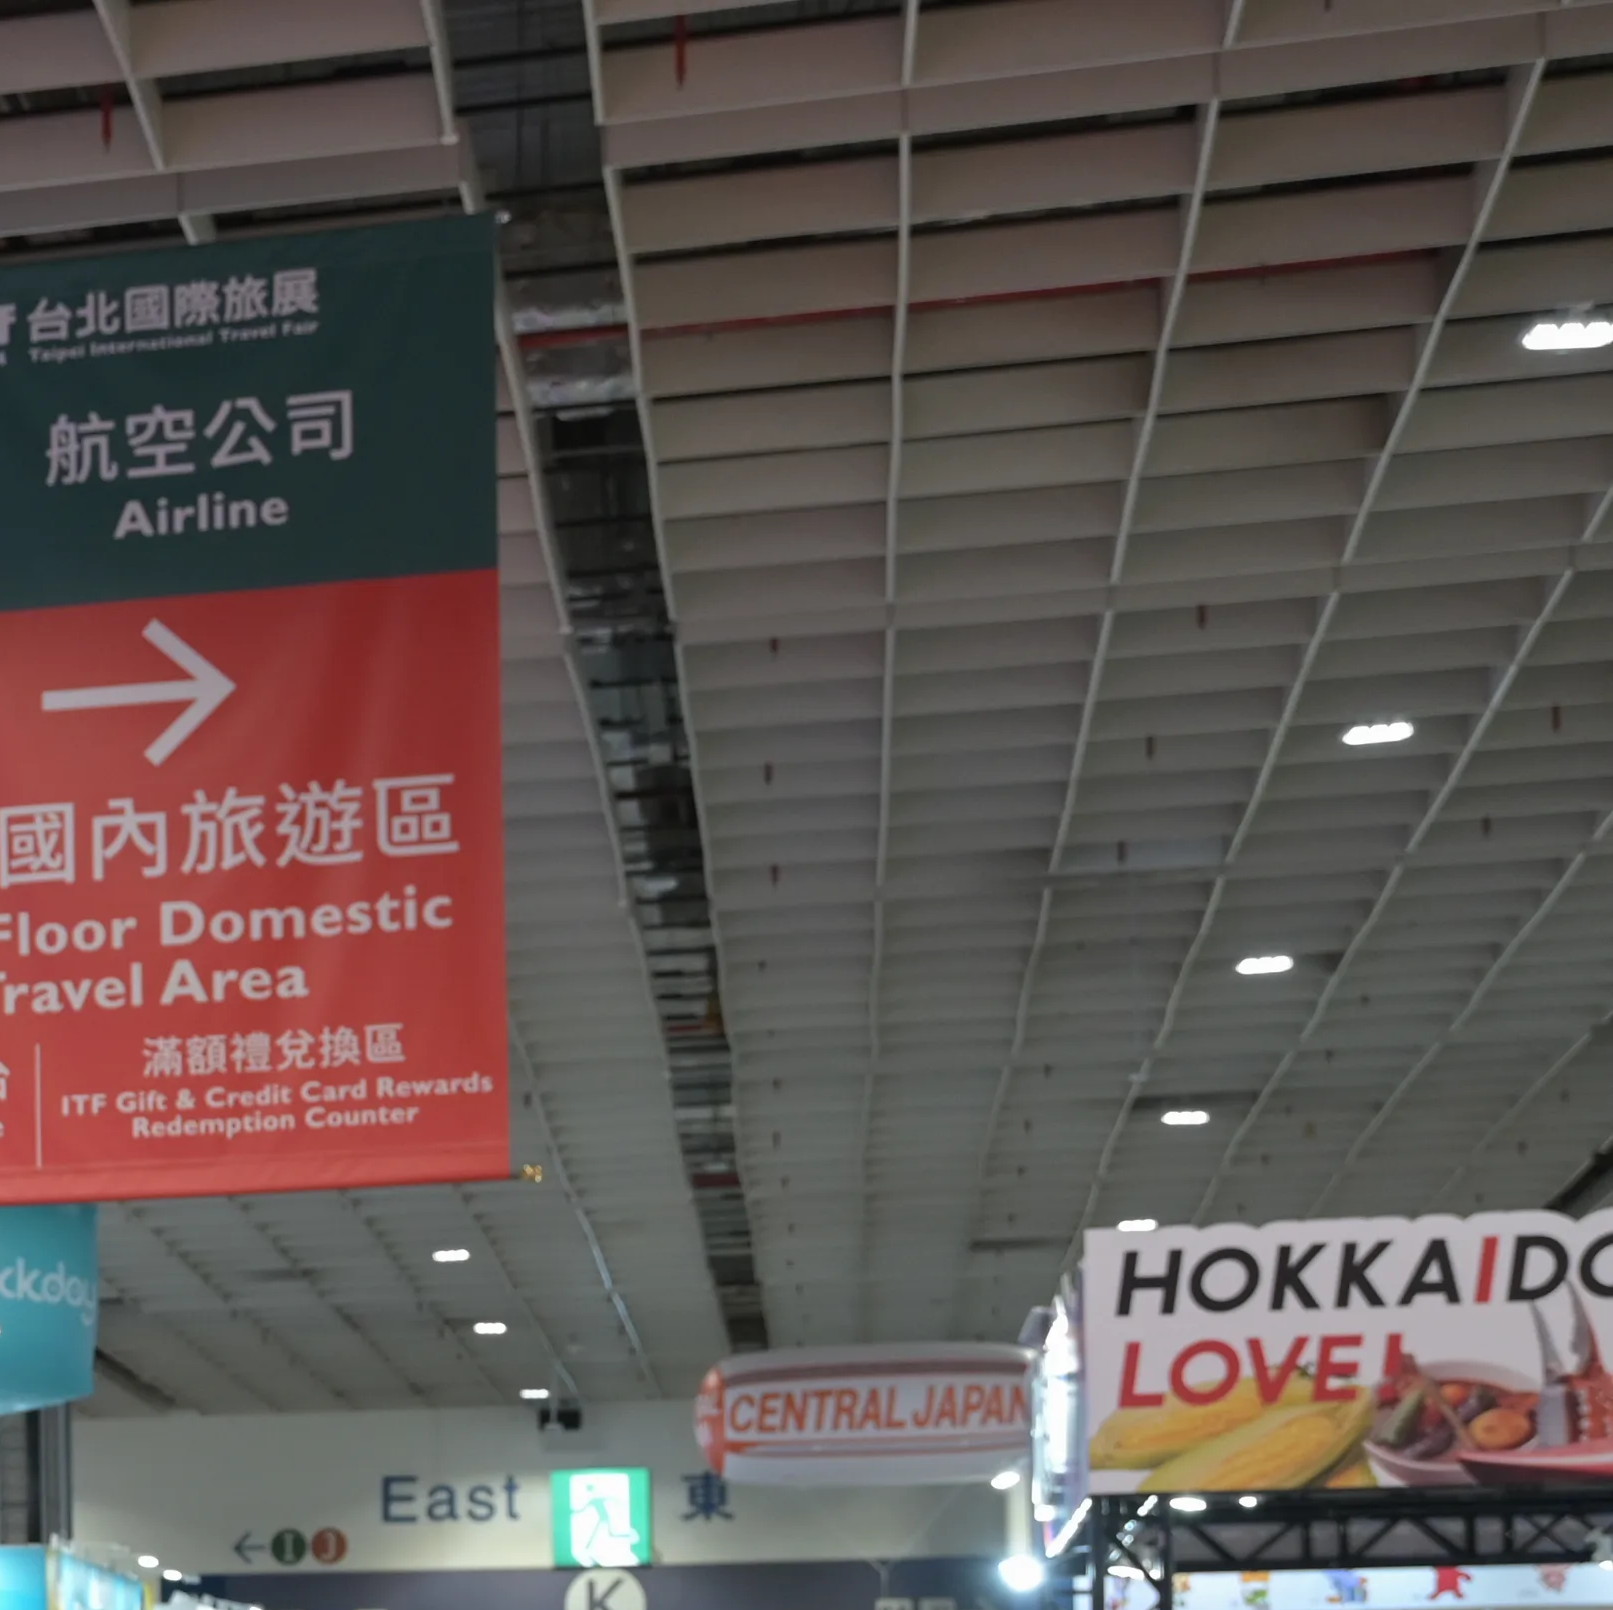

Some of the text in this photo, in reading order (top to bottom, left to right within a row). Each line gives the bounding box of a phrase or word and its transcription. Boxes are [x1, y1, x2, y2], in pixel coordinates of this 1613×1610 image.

[28, 268, 319, 344] 台北國際旅展
[29, 320, 319, 363] Taipei International Travel Fair
[45, 389, 355, 488] 航空公司
[114, 494, 289, 540] Airline
[159, 886, 453, 947] Domestic
[161, 958, 309, 1006] Area
[61, 1072, 493, 1117] ITF Gift & Credit Card Rewards
[132, 1105, 420, 1140] Redemption Counter
[1118, 1332, 1404, 1408] LOVE!
[730, 1386, 906, 1433] CENTRAL
[381, 1475, 520, 1523] East
[682, 1472, 735, 1522] 東
